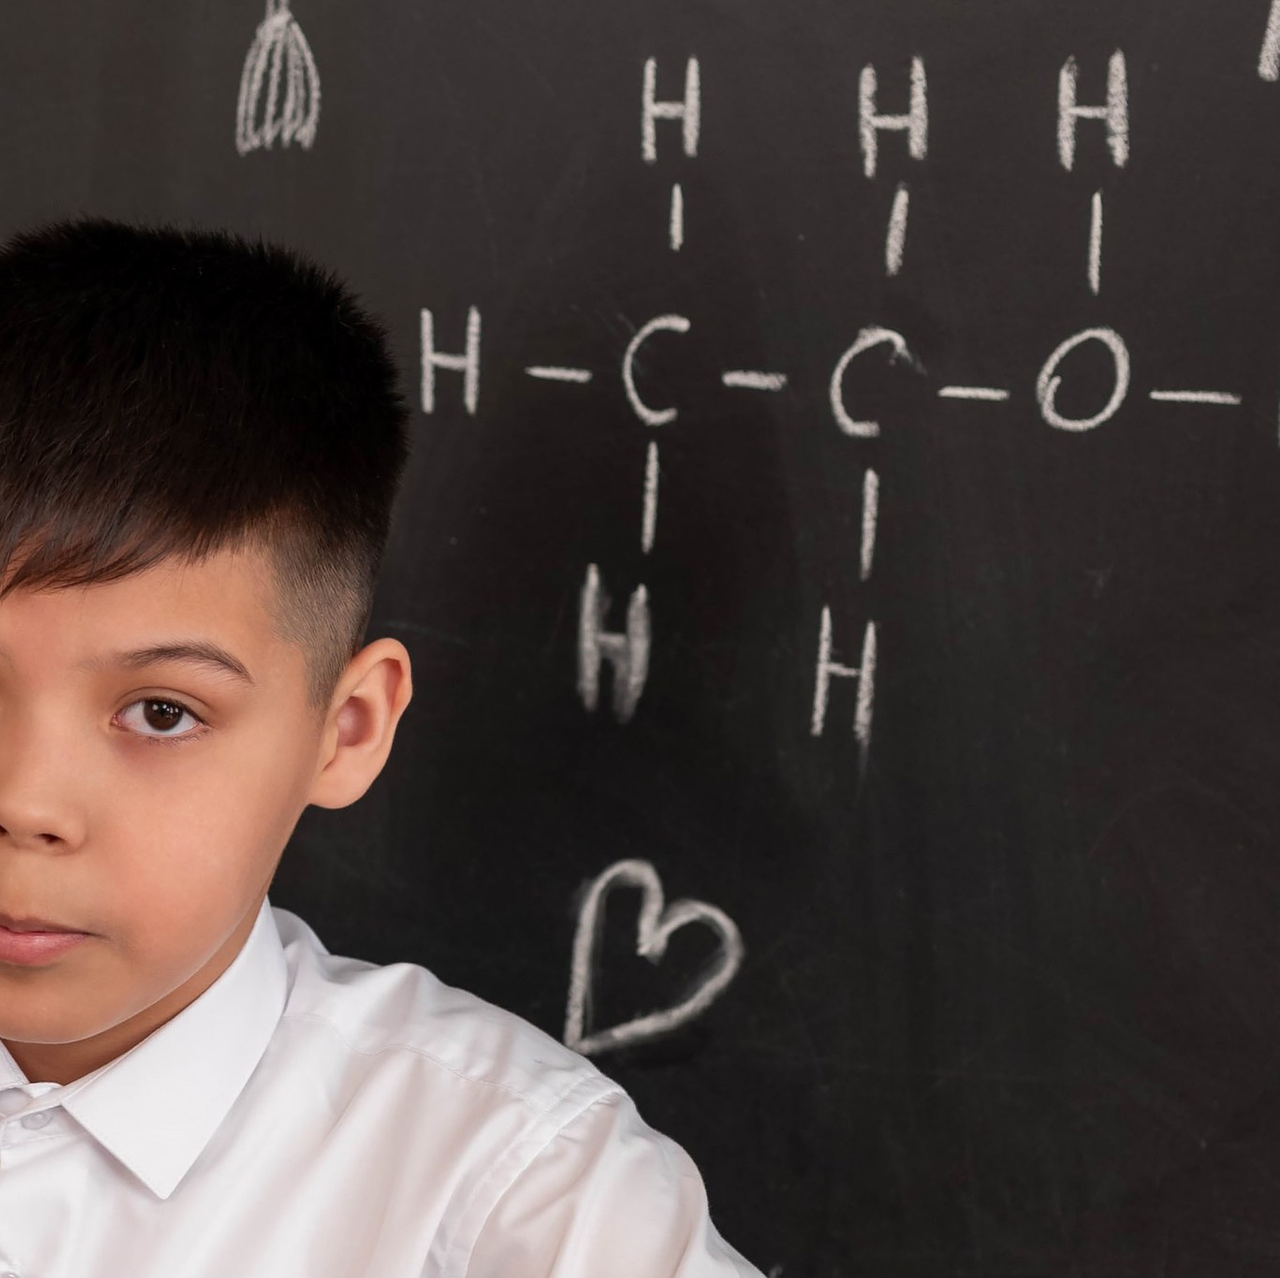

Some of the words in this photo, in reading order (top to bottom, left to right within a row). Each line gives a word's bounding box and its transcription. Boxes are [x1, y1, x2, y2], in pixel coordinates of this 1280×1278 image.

[639, 56, 702, 163] H
[857, 55, 930, 179] H
[1056, 48, 1131, 172] H
[810, 604, 878, 741] H
